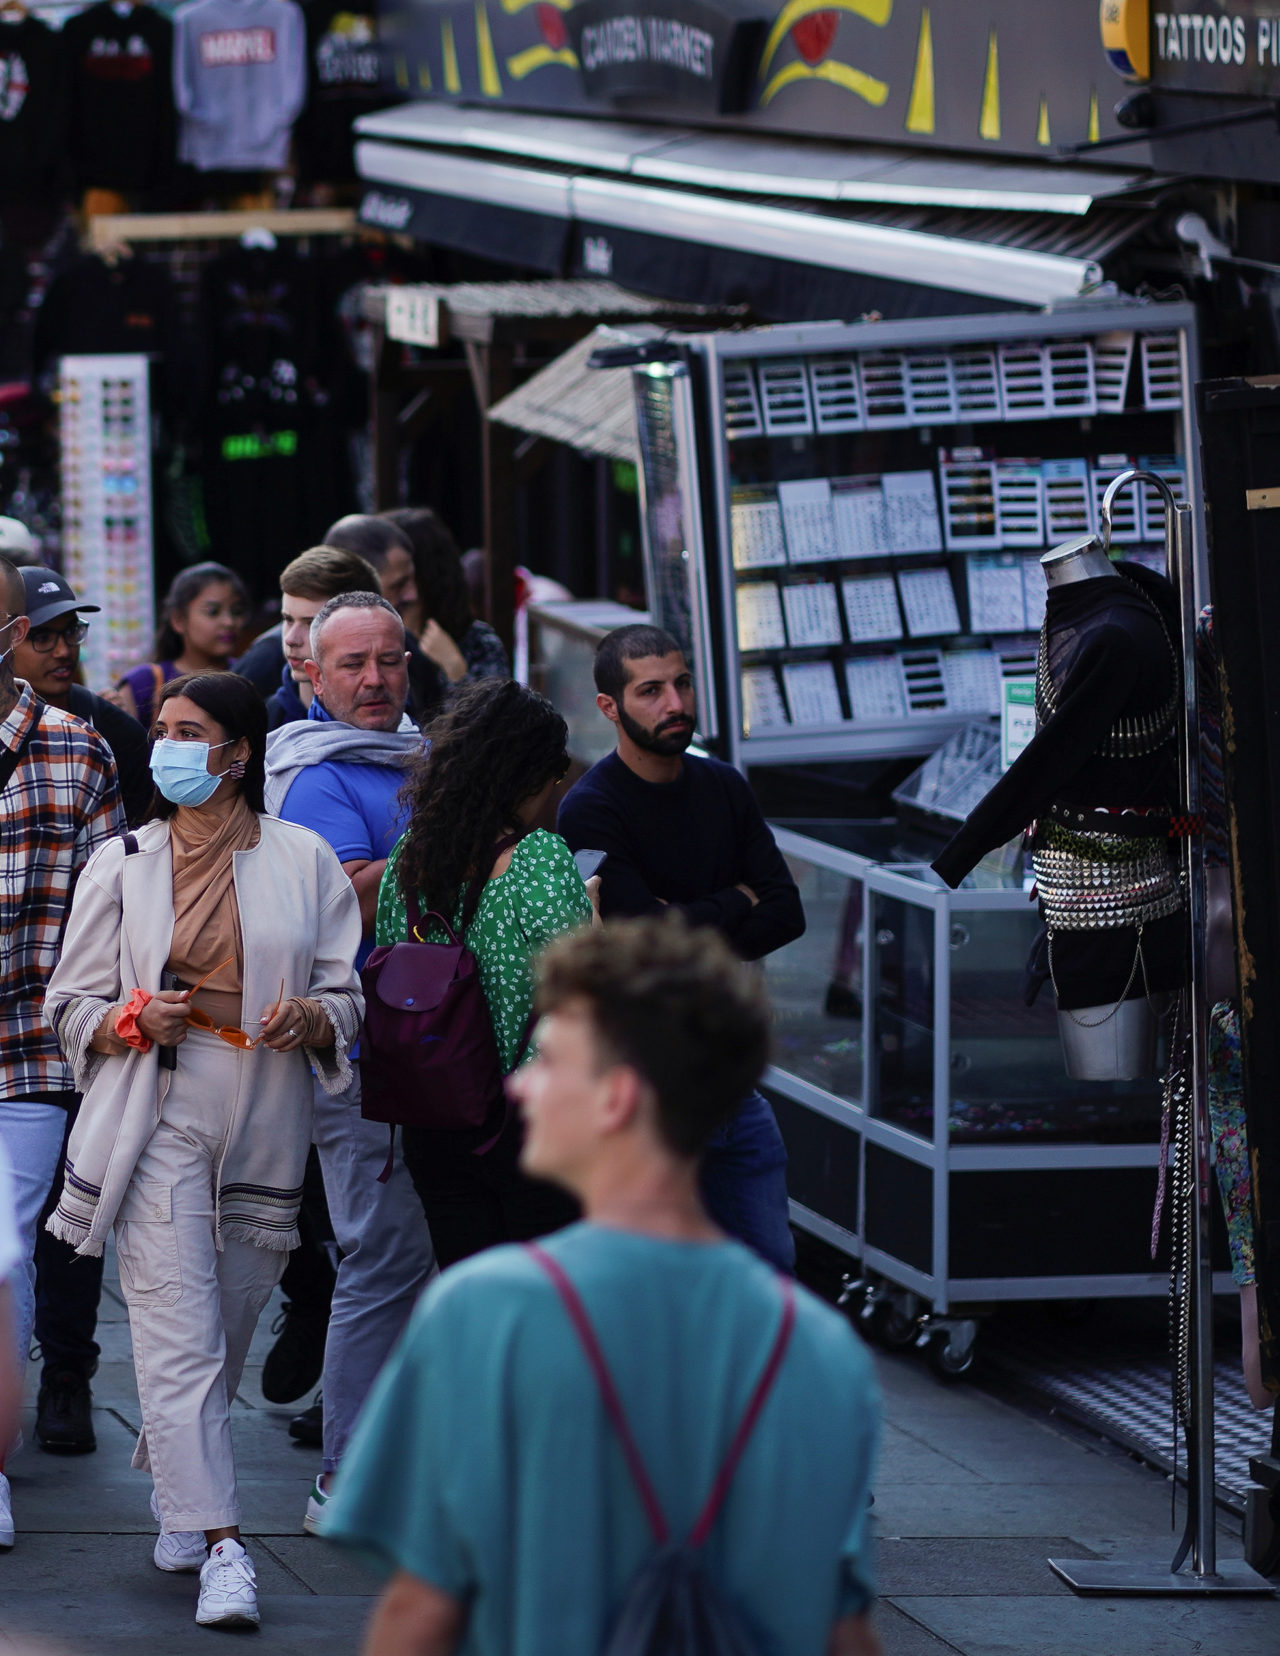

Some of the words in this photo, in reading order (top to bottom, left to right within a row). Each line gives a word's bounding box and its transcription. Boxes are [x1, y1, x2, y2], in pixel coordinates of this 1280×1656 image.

[201, 28, 275, 65] MARVEL
[581, 15, 648, 71] CAMDEN
[649, 17, 714, 79] MARKET
[1155, 13, 1246, 65] TATTOOS
[1258, 18, 1280, 66] PI
